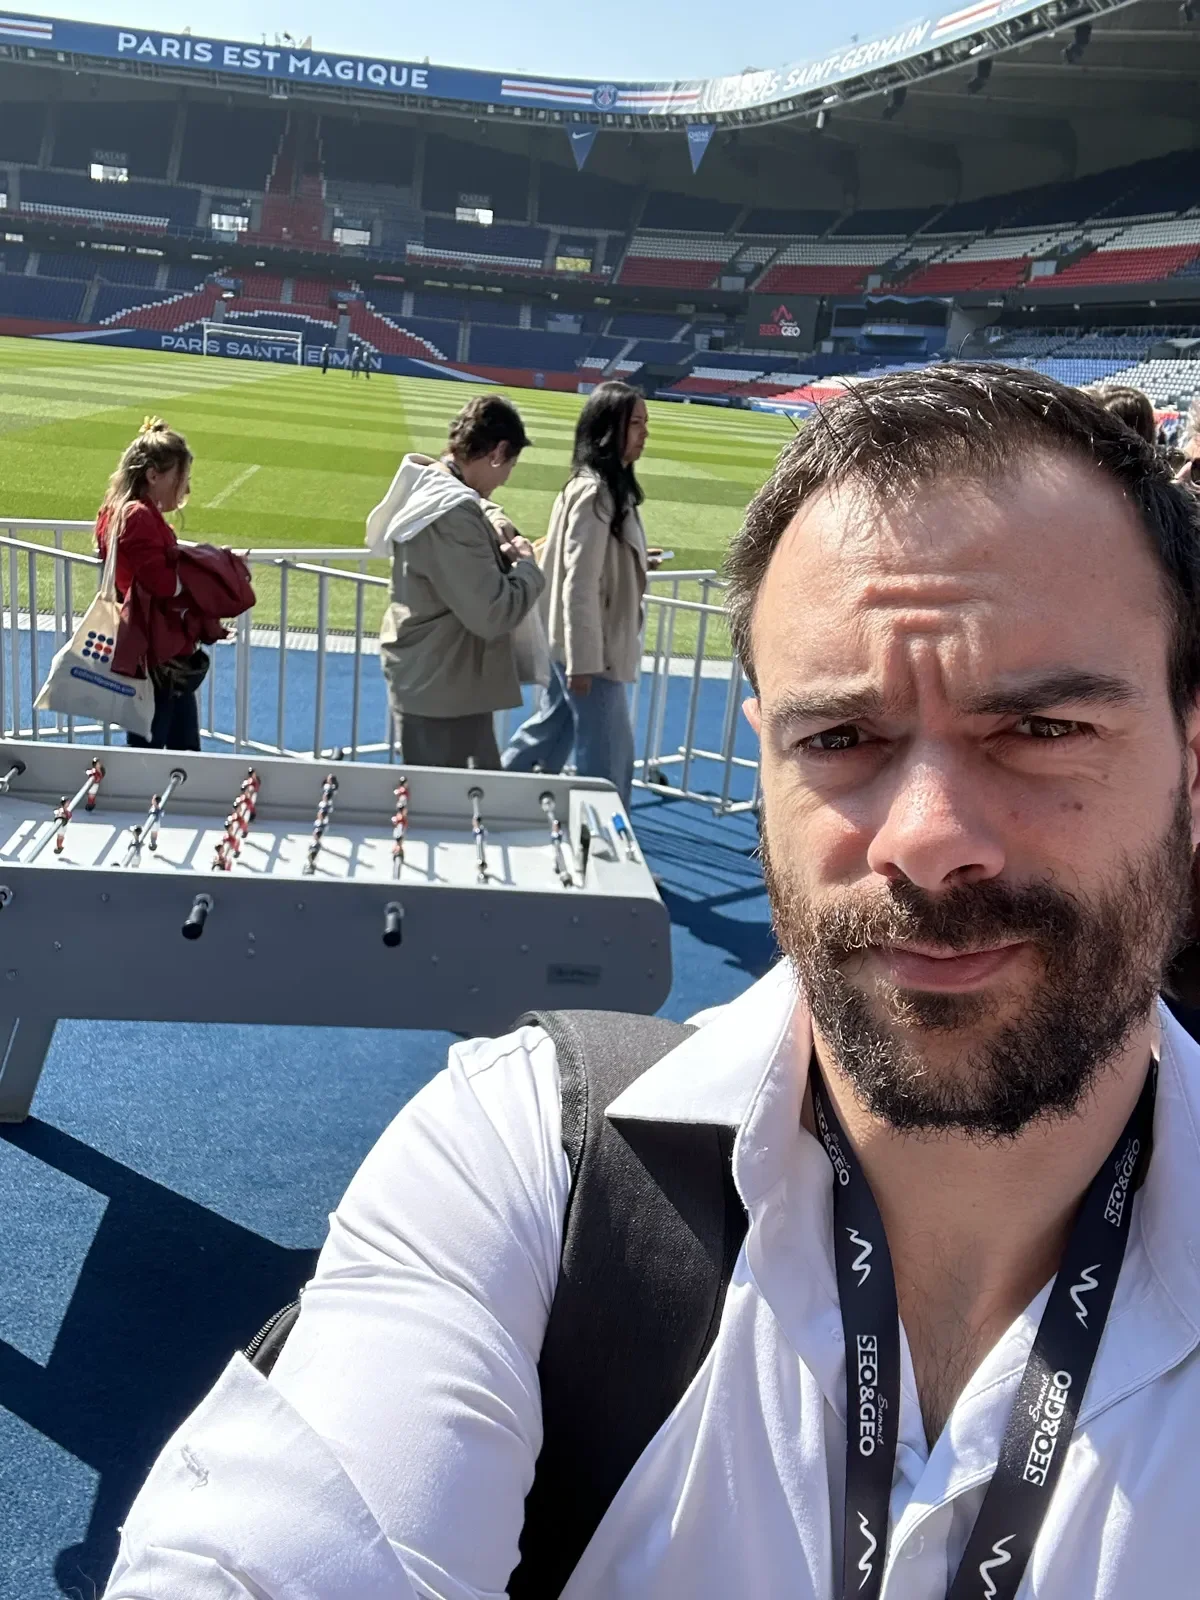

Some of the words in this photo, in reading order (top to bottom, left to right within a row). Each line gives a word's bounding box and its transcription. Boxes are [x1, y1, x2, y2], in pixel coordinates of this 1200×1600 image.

[117, 32, 213, 63] PARIS
[223, 45, 281, 71] EST
[288, 54, 429, 89] MAGIQUE
[783, 20, 931, 92] SAINT-GERMAIN
[161, 335, 220, 353] PARS
[1104, 1138, 1141, 1227] SEO&GEO
[857, 1334, 877, 1457] SEO&GEO
[877, 1393, 889, 1445] Summit
[1028, 1373, 1050, 1423] Summit
[1022, 1370, 1073, 1487] SEO&GEO
